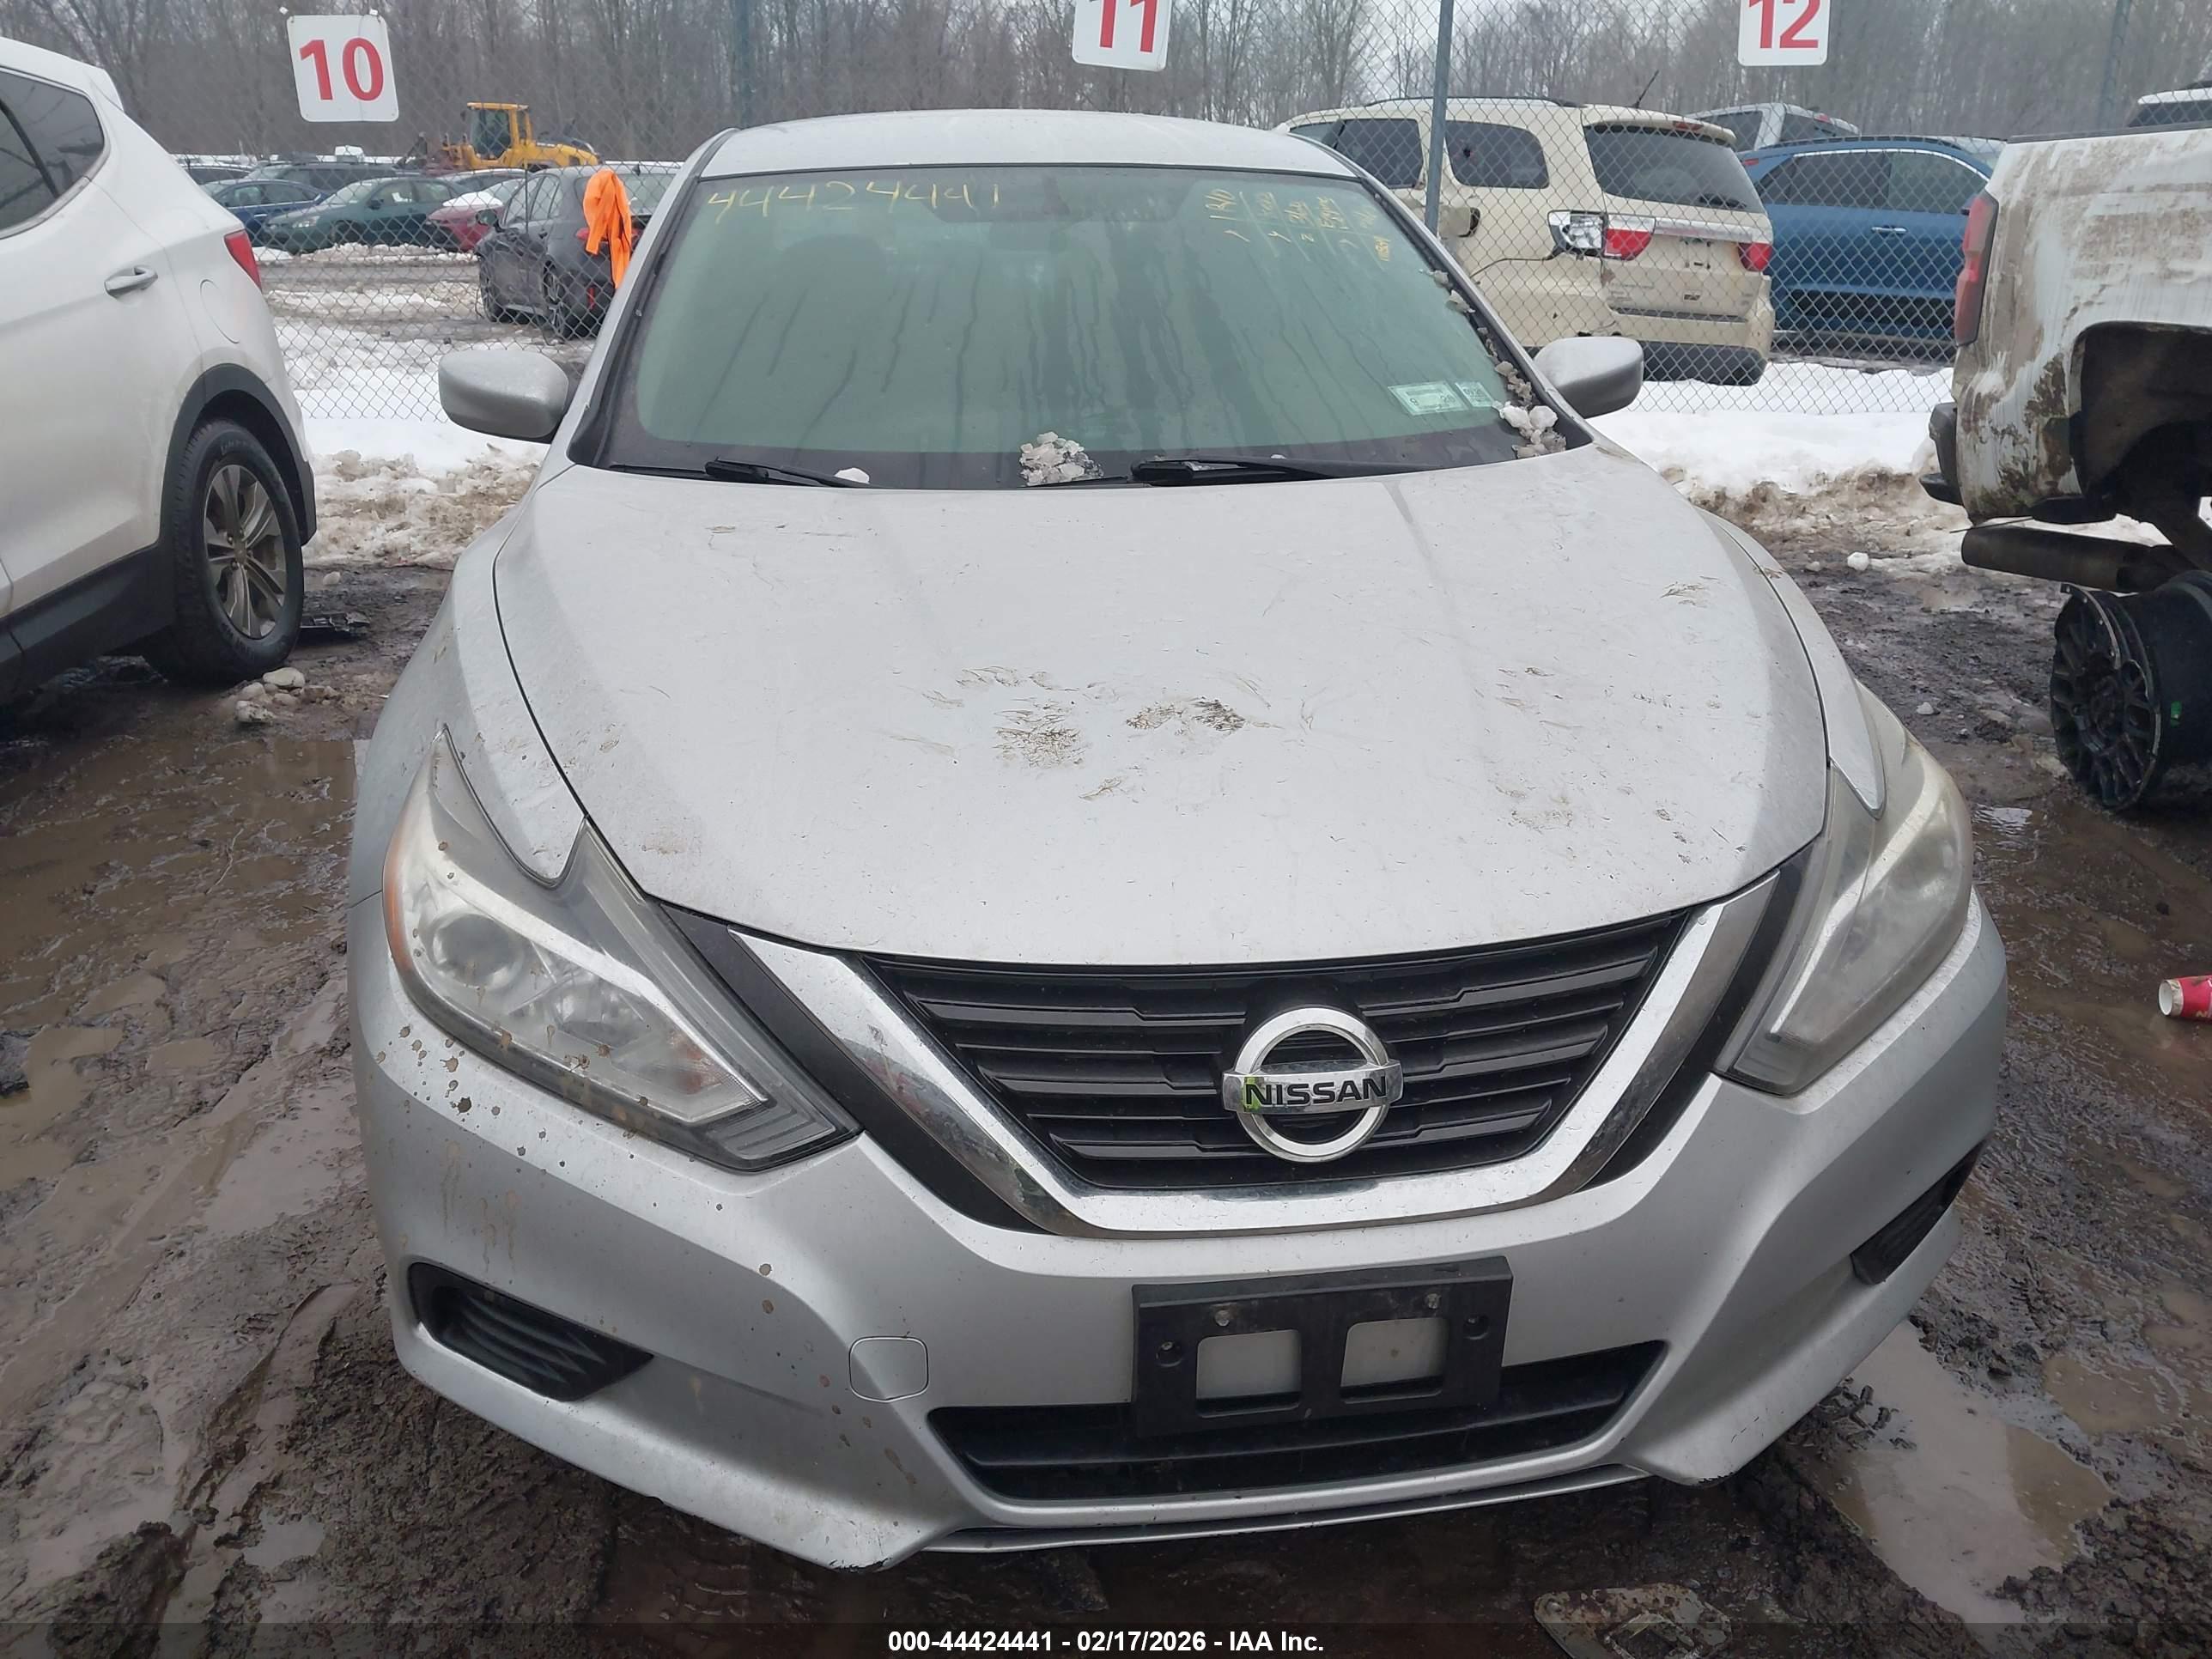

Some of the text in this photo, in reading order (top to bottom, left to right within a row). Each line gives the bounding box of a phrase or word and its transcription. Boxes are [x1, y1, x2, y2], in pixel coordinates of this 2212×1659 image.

[1094, 0, 1158, 52] 11
[1749, 0, 1820, 48] 12
[299, 38, 384, 101] 10
[708, 180, 1000, 225] 44424441
[1245, 1075, 1388, 1105] NISSAN
